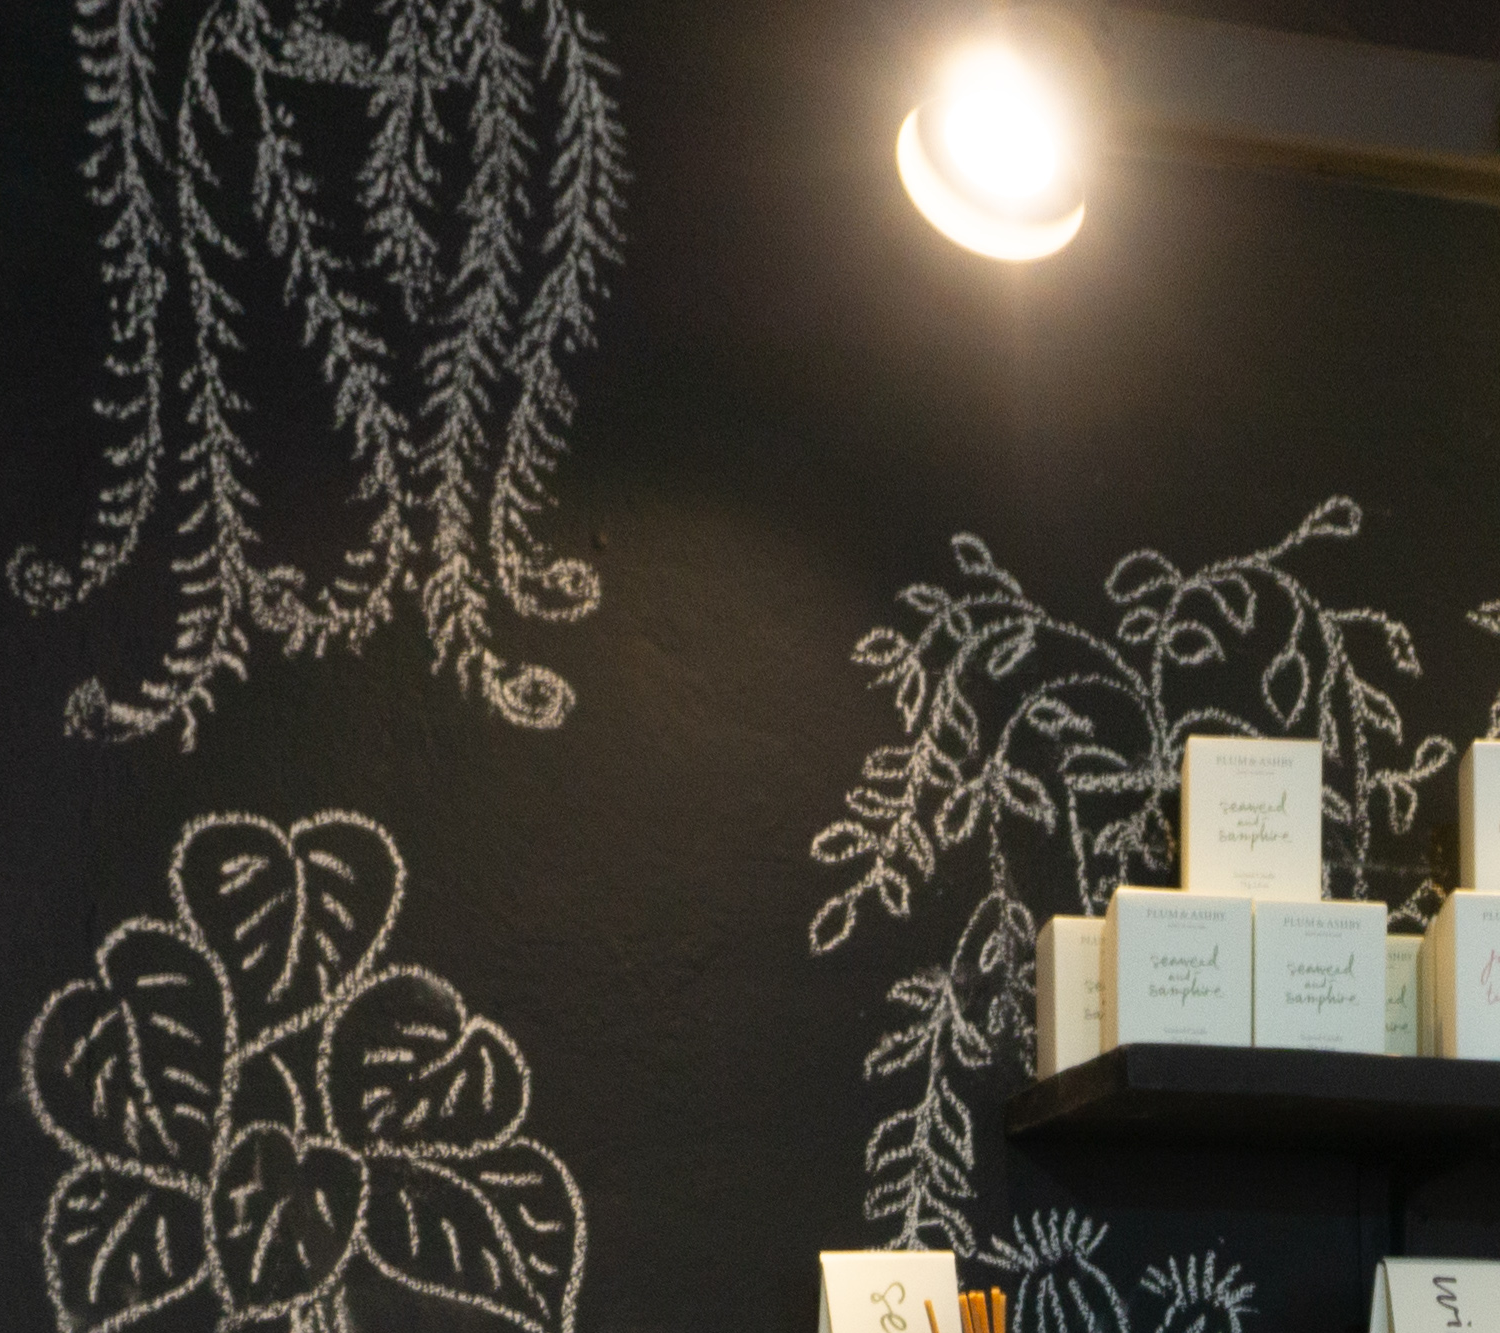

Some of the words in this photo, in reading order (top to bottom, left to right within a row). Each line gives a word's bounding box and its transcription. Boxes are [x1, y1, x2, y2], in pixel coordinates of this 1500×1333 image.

[1219, 791, 1287, 816] seaweed
[1218, 828, 1291, 850] samphire
[1150, 945, 1219, 970] seaweed
[1287, 954, 1355, 977] seaweed
[1149, 982, 1224, 1006] samphire
[1286, 989, 1359, 1014] samphire
